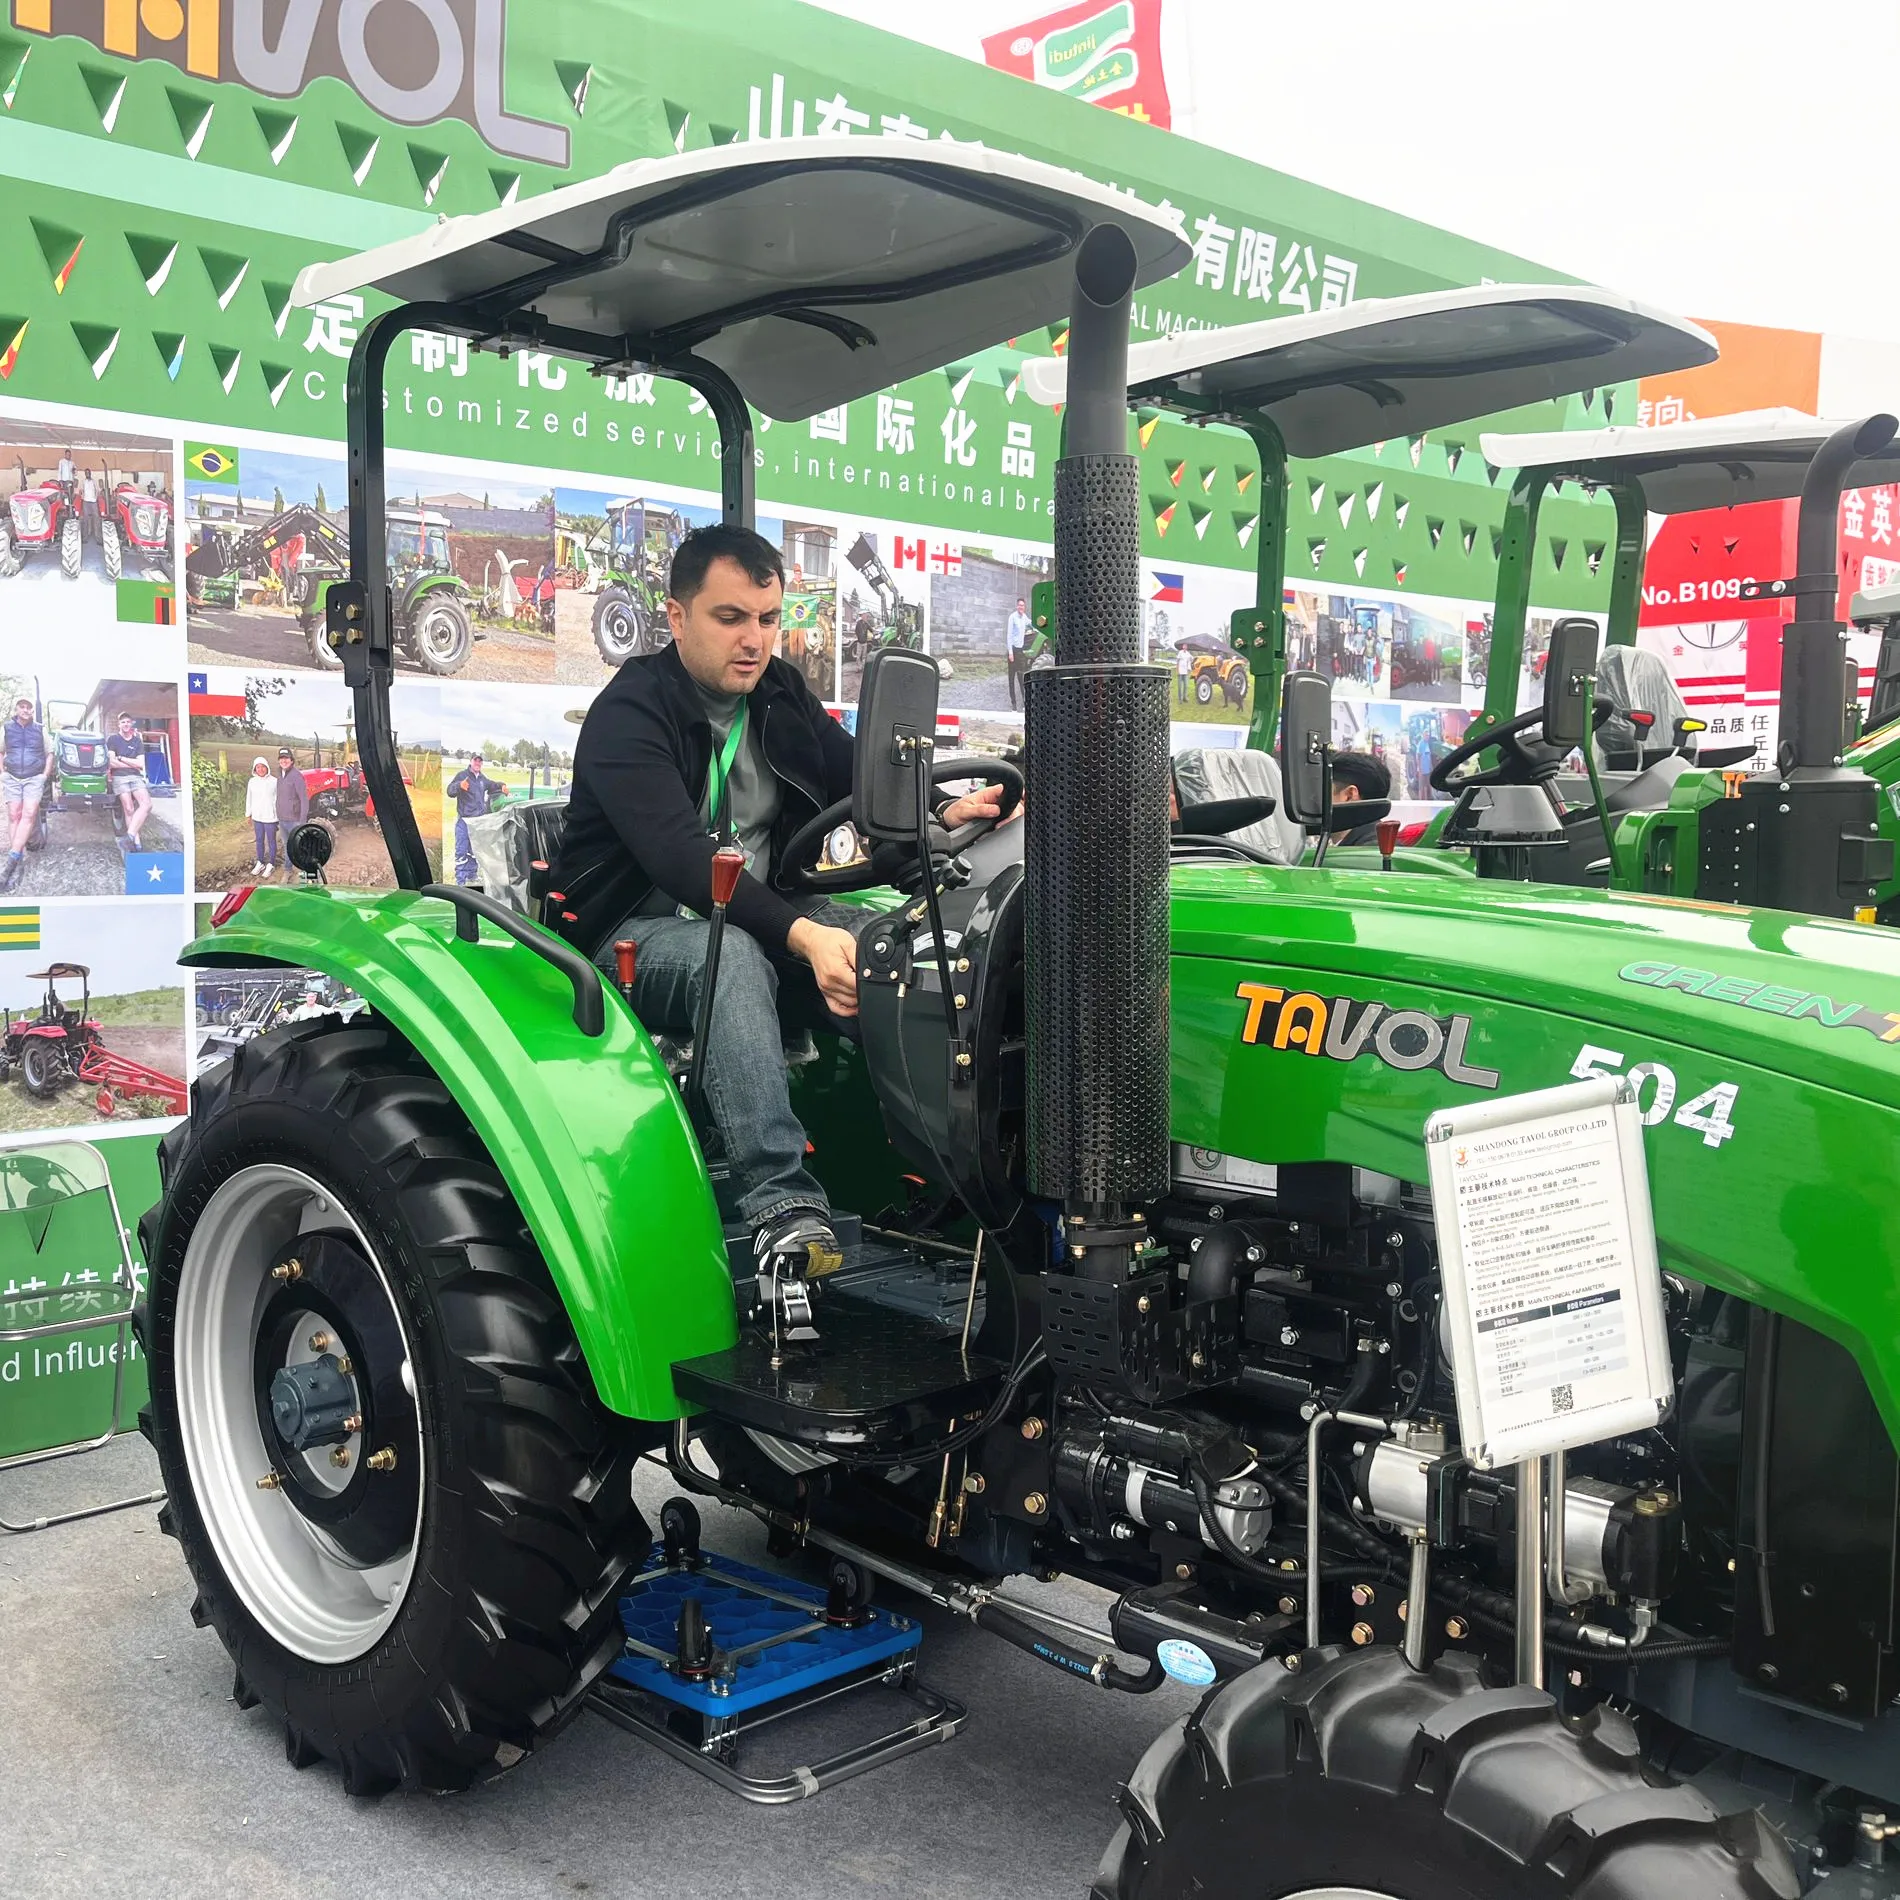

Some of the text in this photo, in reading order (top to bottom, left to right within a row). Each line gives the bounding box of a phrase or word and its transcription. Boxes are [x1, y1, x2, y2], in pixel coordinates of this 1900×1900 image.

[303, 371, 588, 438] Cstomized
[1619, 960, 1866, 1027] GREEN
[1236, 981, 1500, 1090] TAVOL
[1473, 1136, 1518, 1153] SHANDONG
[1519, 1131, 1546, 1144] TAVOL
[1547, 1125, 1575, 1138] GROUP
